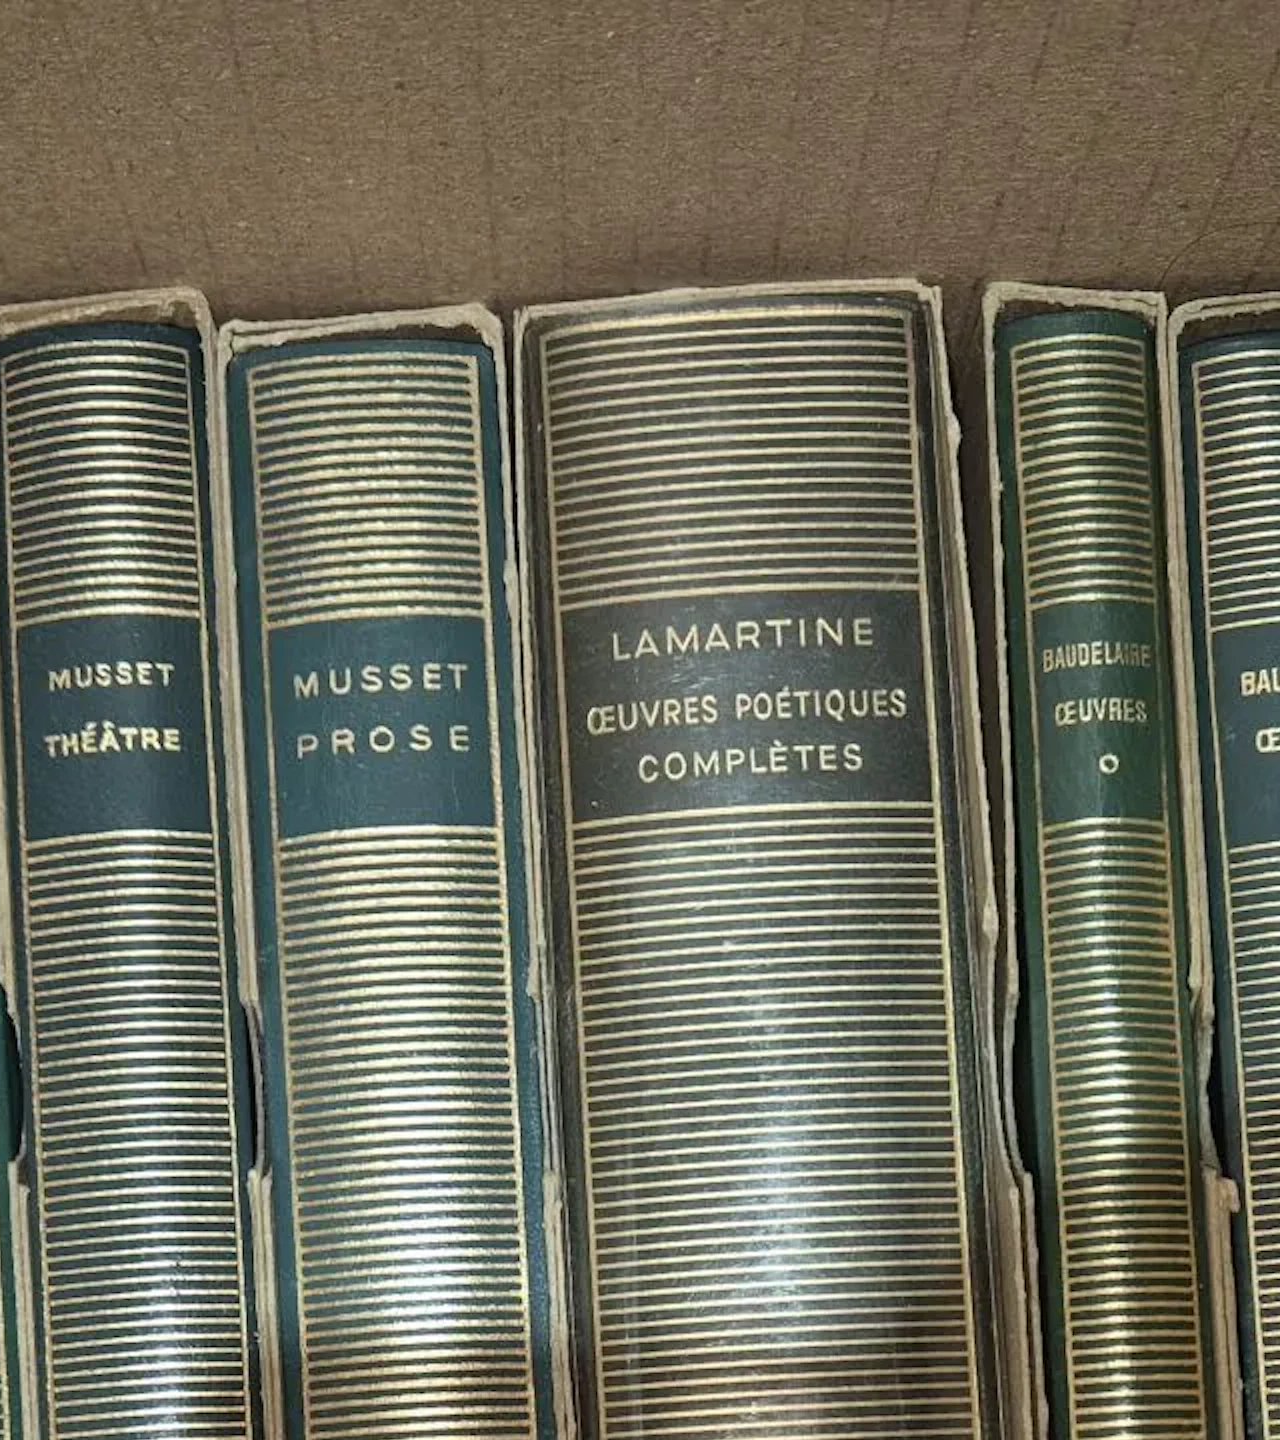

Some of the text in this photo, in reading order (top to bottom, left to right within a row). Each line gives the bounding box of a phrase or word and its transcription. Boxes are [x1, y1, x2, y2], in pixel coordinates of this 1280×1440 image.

[612, 616, 874, 661] LAMARTINE
[1042, 640, 1152, 673] BAUDELAIRE
[47, 661, 176, 691] MUSSET
[292, 663, 469, 697] MUSSET
[586, 687, 908, 736] ŒUVRES POÉTIQUES
[1054, 697, 1148, 727] ŒUVRES
[44, 721, 182, 759] THÉÂTRE
[296, 724, 470, 760] PROSE
[638, 740, 864, 784] COMPLÈTES
